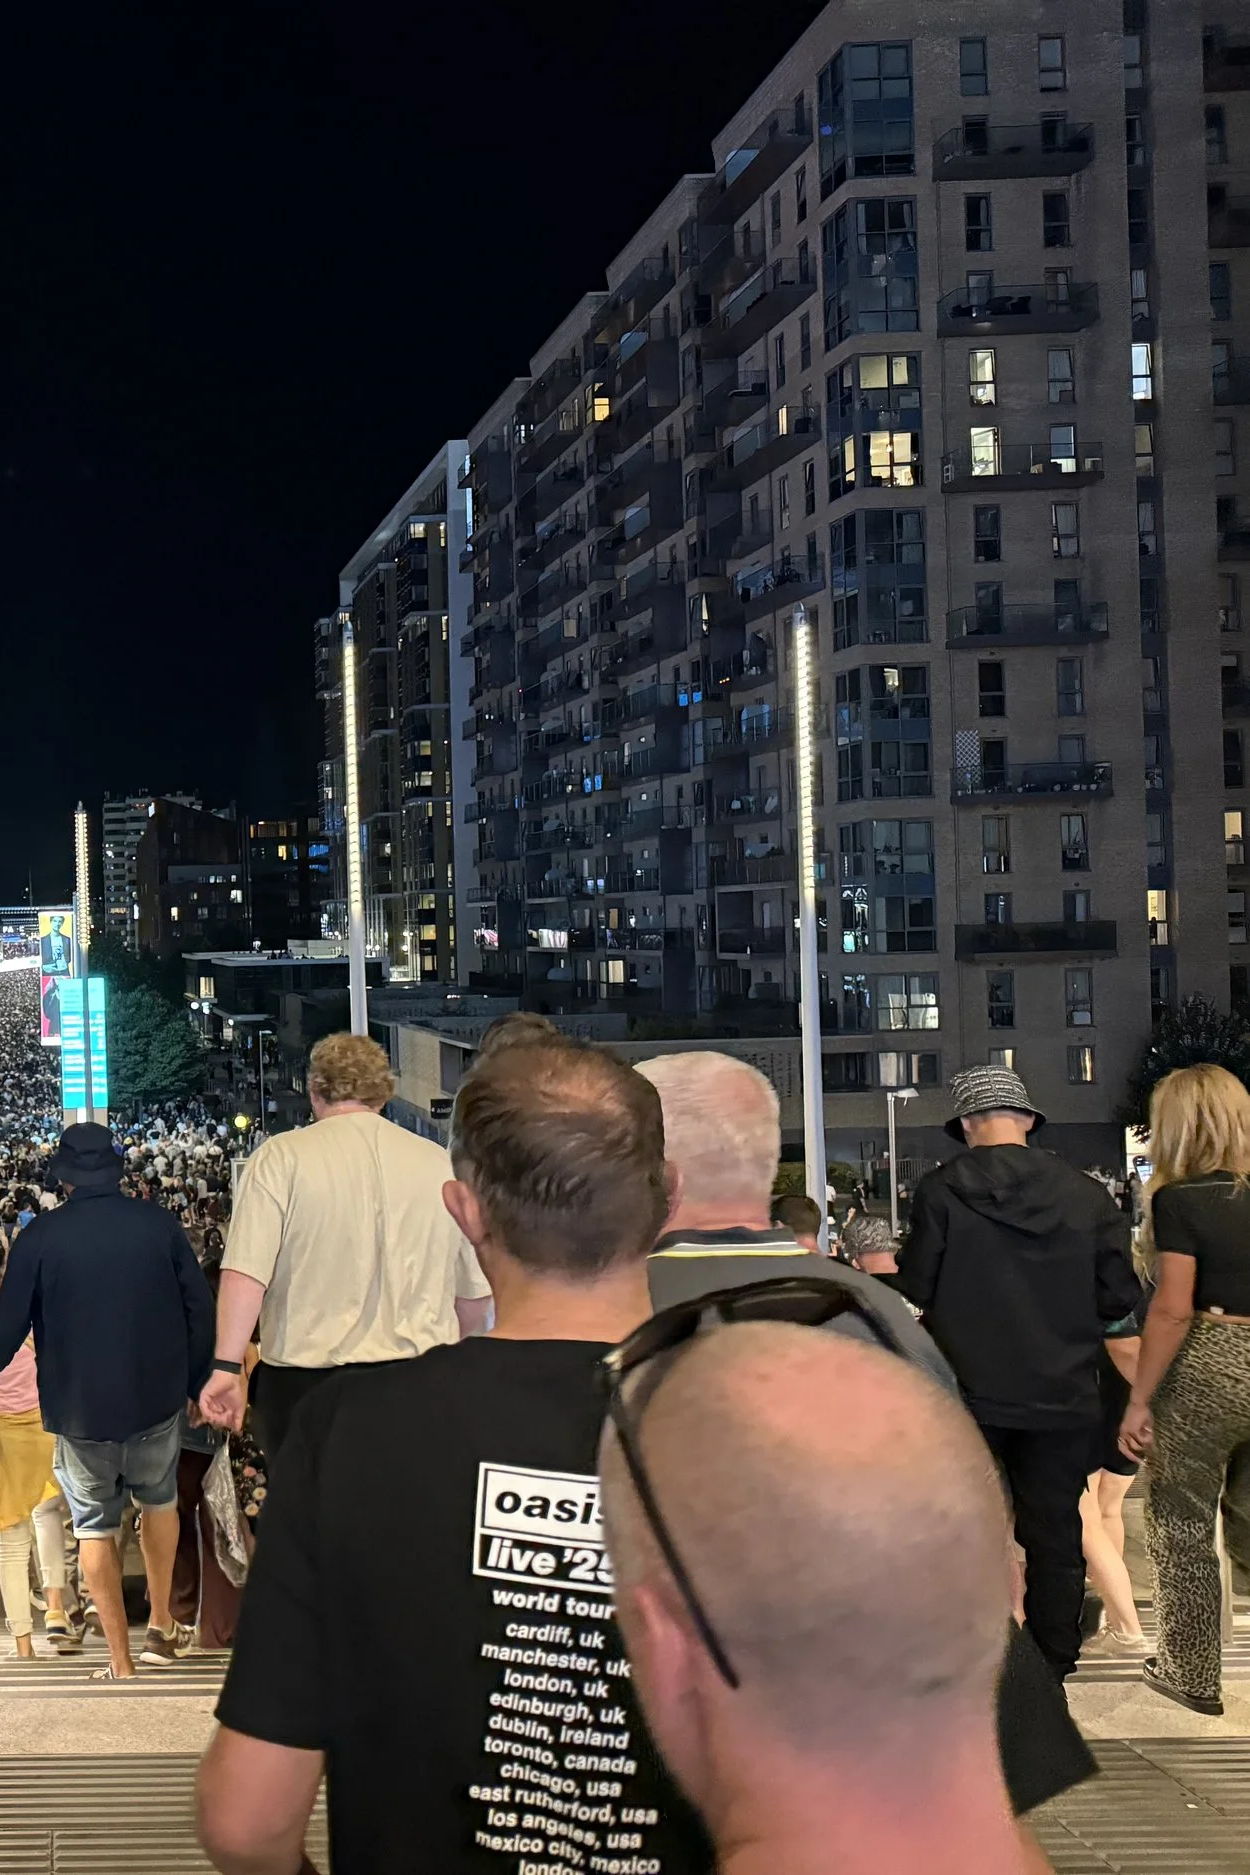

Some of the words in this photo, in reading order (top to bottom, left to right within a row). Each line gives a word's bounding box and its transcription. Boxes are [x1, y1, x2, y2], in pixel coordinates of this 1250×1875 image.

[487, 1537, 557, 1576] live
[492, 1589, 561, 1613] world
[565, 1597, 617, 1620] tour
[505, 1622, 574, 1648] cardiff,
[579, 1631, 605, 1650] uk
[481, 1643, 600, 1675] manchester,
[605, 1659, 632, 1677] uk
[503, 1668, 578, 1697] london,
[583, 1680, 609, 1698] uk
[489, 1692, 594, 1724] edinburgh,
[599, 1706, 627, 1725] uk
[489, 1713, 555, 1744] dublin,
[560, 1725, 630, 1750] ireland
[484, 1736, 558, 1769] toronto,
[564, 1754, 637, 1775] canada
[500, 1763, 581, 1798] chicago,
[586, 1780, 623, 1797] usa
[468, 1784, 511, 1803] east
[515, 1787, 616, 1826] rutherford,
[620, 1807, 659, 1825] usa
[487, 1808, 518, 1827] los
[521, 1813, 601, 1850] angeles,
[607, 1832, 643, 1849] usa
[475, 1829, 544, 1853] mexico
[548, 1840, 585, 1866] city,
[590, 1855, 660, 1875] mexico
